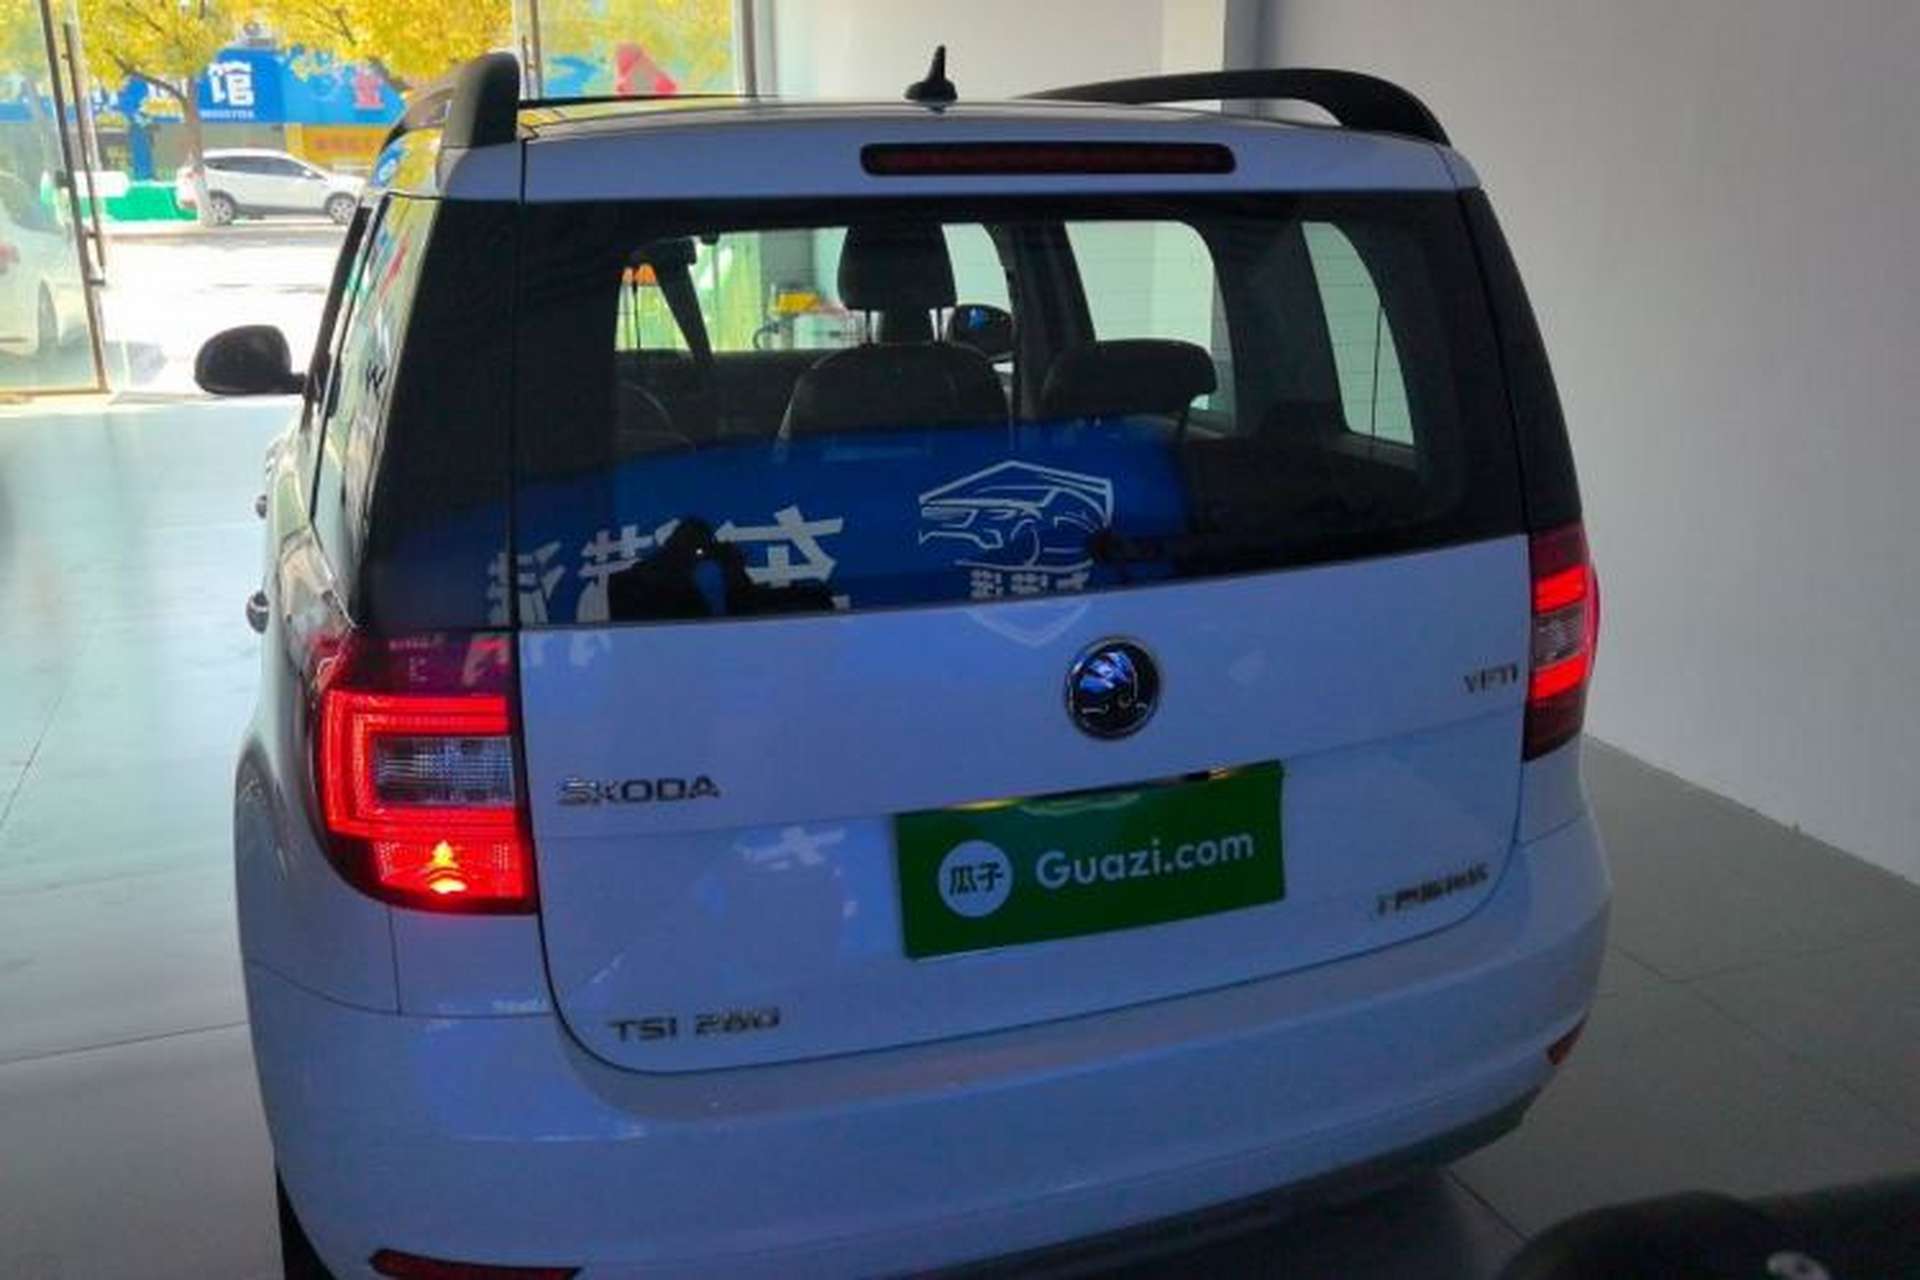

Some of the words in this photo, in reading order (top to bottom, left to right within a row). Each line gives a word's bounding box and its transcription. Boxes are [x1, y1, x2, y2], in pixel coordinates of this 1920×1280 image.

[1035, 832, 1255, 889] Guazi.com
[949, 861, 1003, 896] 瓜子
[608, 1014, 678, 1043] TSI
